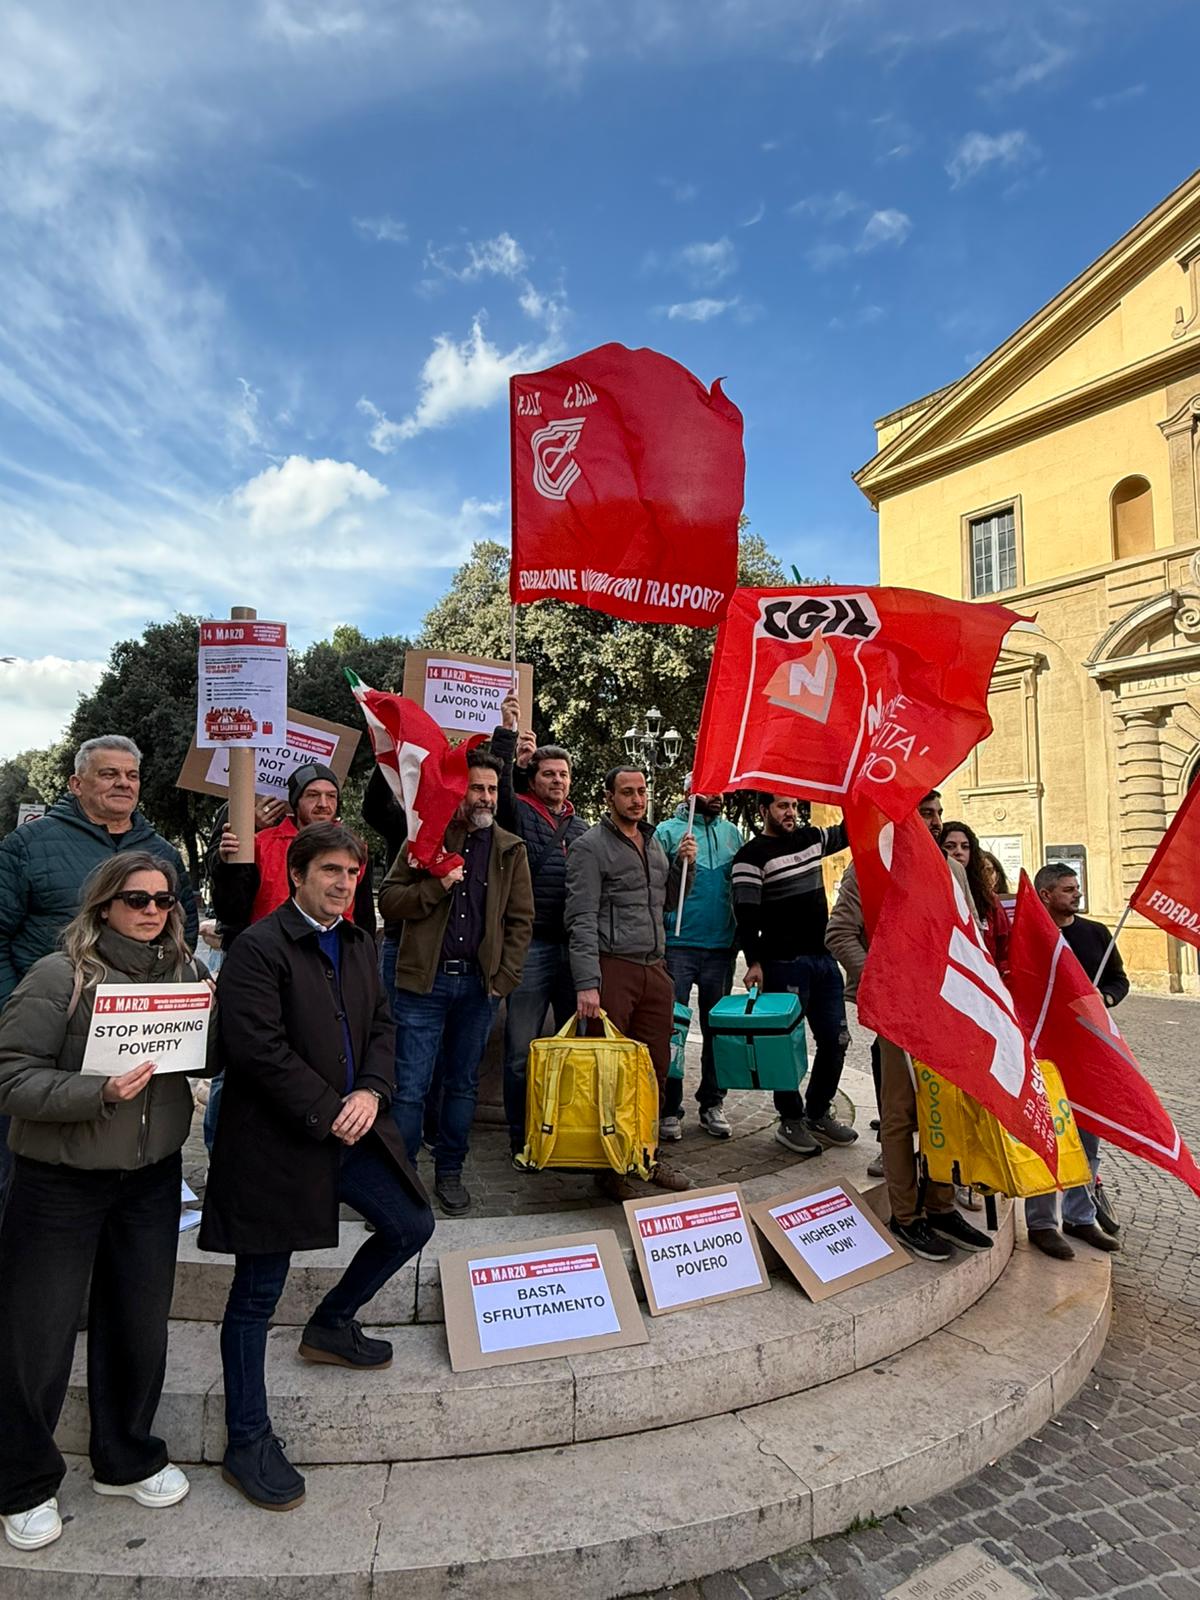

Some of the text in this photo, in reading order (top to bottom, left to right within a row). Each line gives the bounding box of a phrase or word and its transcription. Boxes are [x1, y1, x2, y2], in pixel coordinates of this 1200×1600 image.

[643, 579, 725, 613] TRASPORTI
[763, 599, 877, 639] CGIL
[203, 629, 212, 640] 14
[216, 628, 244, 640] MARZO
[429, 668, 439, 678] 14
[440, 668, 467, 681] MARZO
[443, 681, 500, 698] IL NOSTRO
[434, 694, 500, 711] LAVORO VAL
[455, 710, 486, 722] DI PIÙ
[275, 747, 291, 759] TO
[258, 757, 285, 772] NOT
[98, 998, 111, 1012] 14
[115, 997, 150, 1011] MARZO
[94, 1020, 204, 1038] STOP WORKING
[118, 1038, 182, 1056] POVERTY
[641, 1221, 653, 1236] 14
[653, 1215, 684, 1233] MARZO
[778, 1217, 791, 1229] 14
[798, 1215, 857, 1246] HIGHER PAY
[650, 1231, 743, 1262] BASTA LAVORO
[826, 1236, 857, 1256] NOW!
[473, 1270, 487, 1284] 14
[491, 1265, 527, 1282] MARZO
[676, 1255, 728, 1278] POVERO
[517, 1283, 566, 1301] BASTA
[482, 1295, 605, 1324] SFRUTTAMENTO
